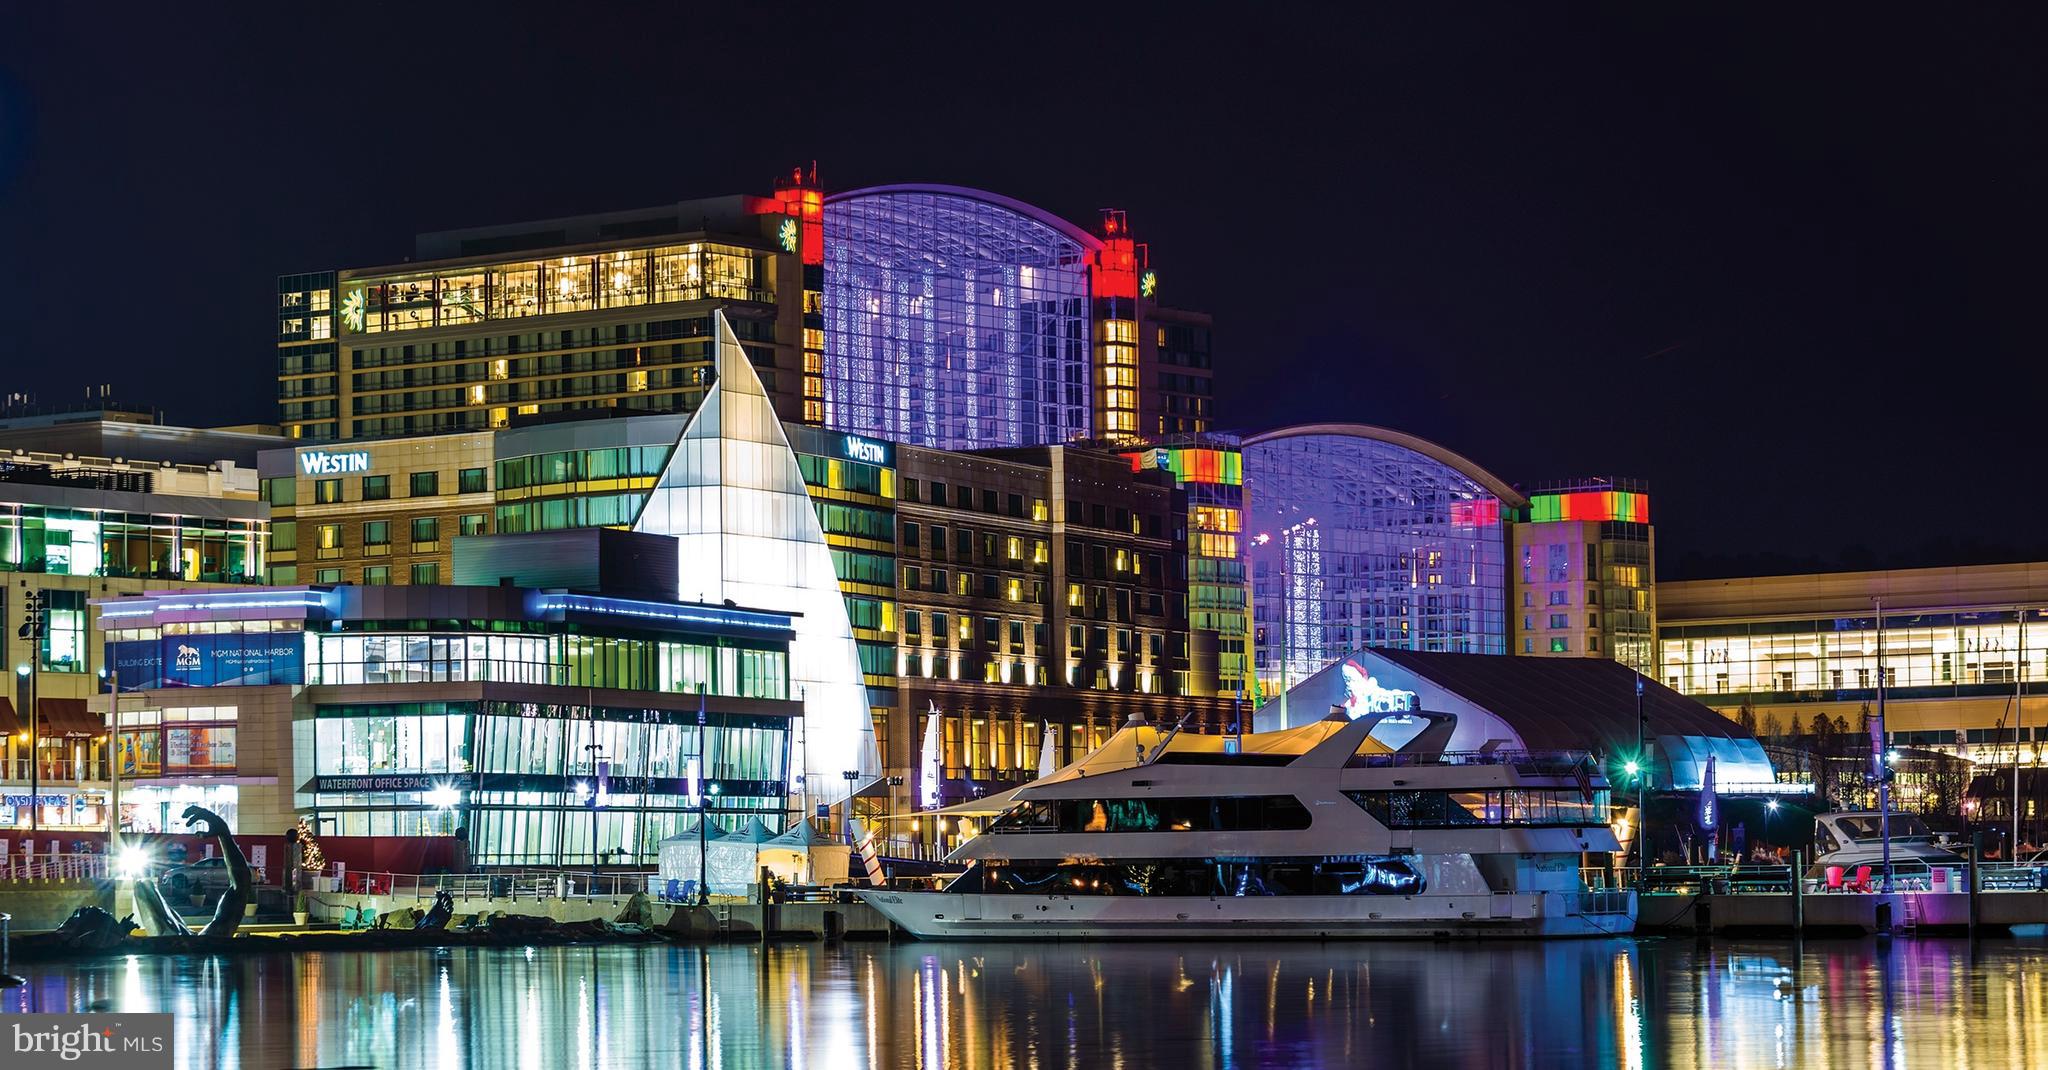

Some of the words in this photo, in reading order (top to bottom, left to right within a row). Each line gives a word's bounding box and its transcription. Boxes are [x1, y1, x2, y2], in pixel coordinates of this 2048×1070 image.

[847, 435, 884, 463] WESTIN
[300, 452, 368, 474] WESTIN
[229, 648, 263, 657] NATONAL
[264, 647, 294, 656] HARBOR
[175, 656, 201, 666] MGM
[319, 778, 373, 790] WATERFRONT
[374, 778, 402, 789] OFFICE
[403, 777, 430, 788] SPACE
